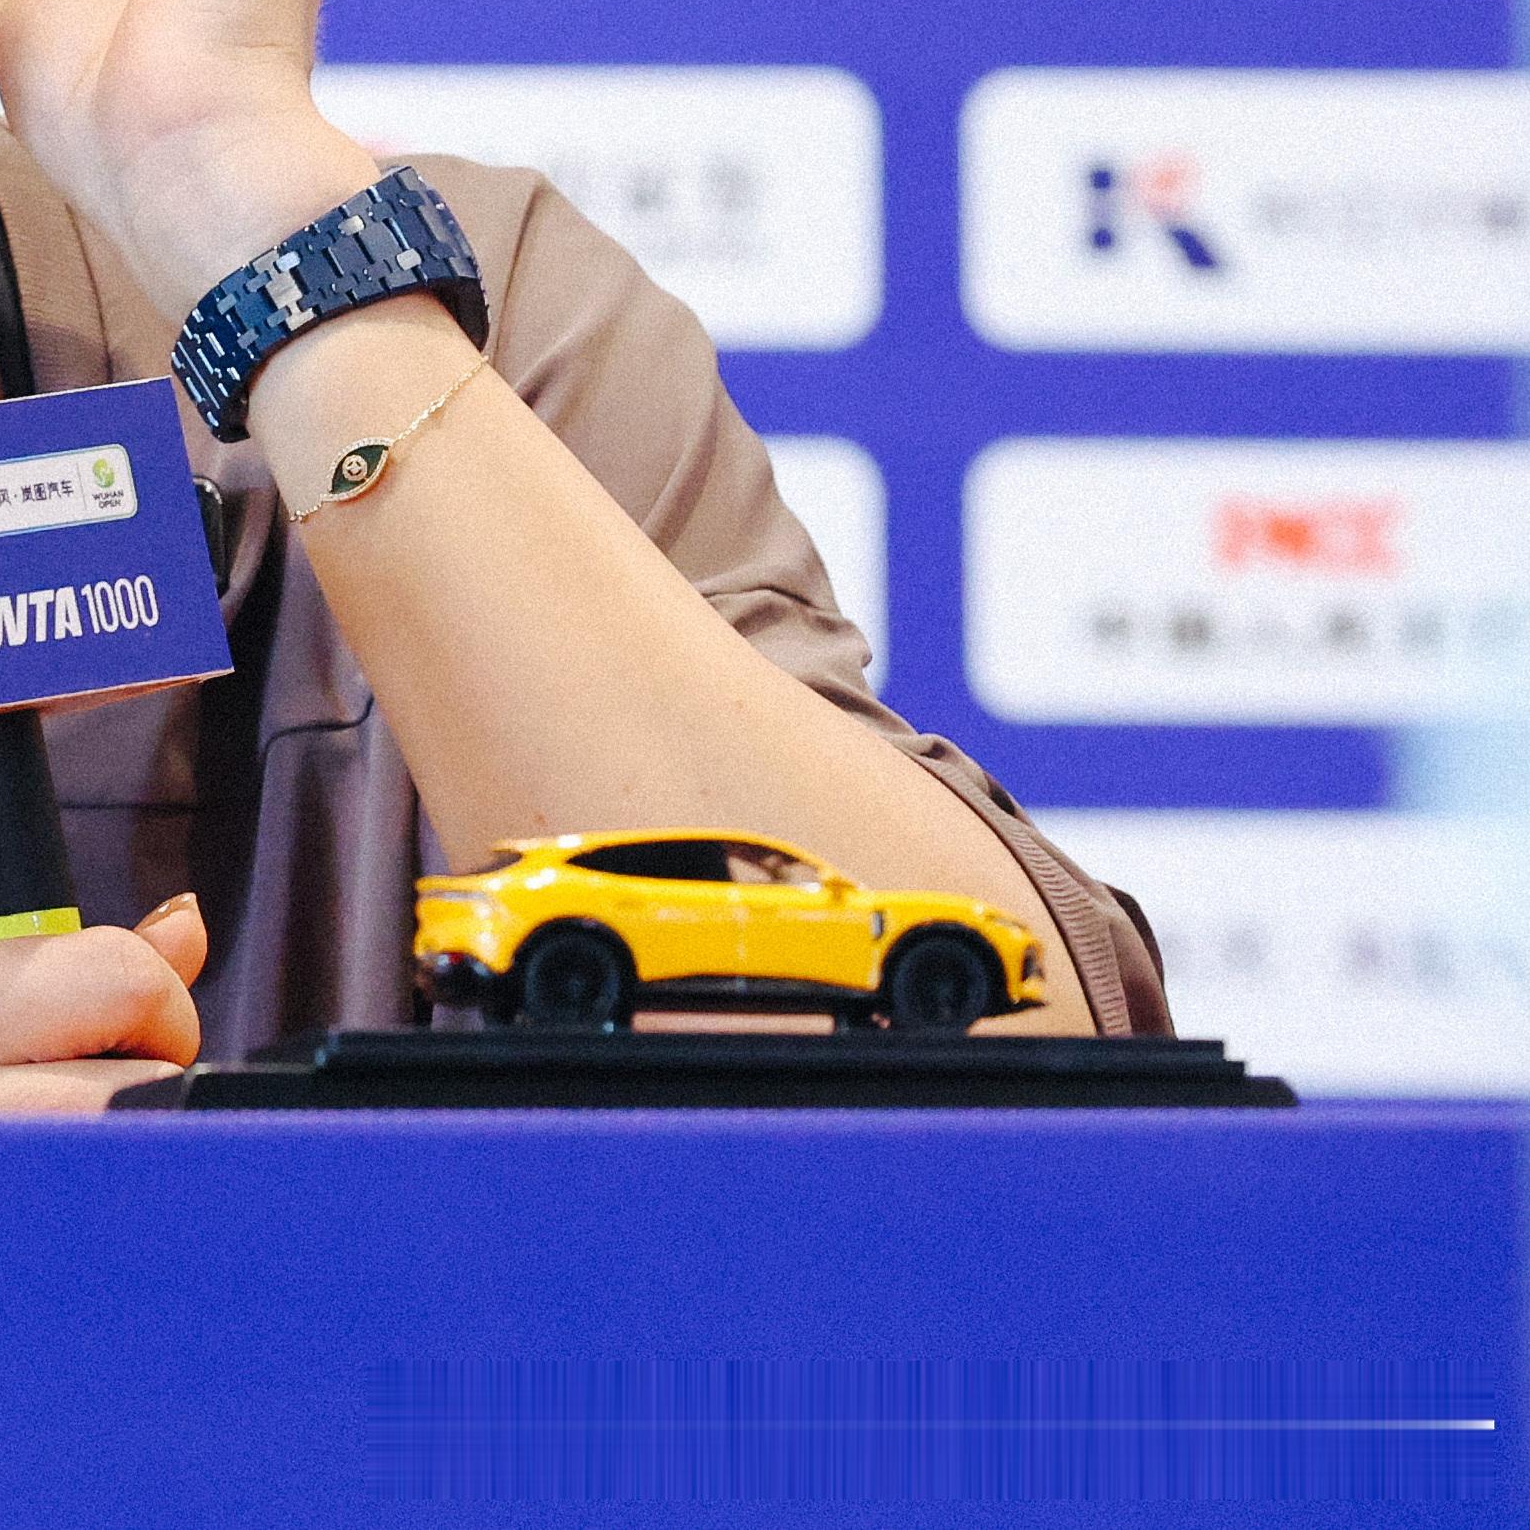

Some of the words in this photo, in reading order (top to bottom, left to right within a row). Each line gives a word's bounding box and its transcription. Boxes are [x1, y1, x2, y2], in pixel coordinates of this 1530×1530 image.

[92, 489, 124, 501] WUHAN
[98, 499, 122, 509] OPEN
[81, 574, 159, 634] 1000
